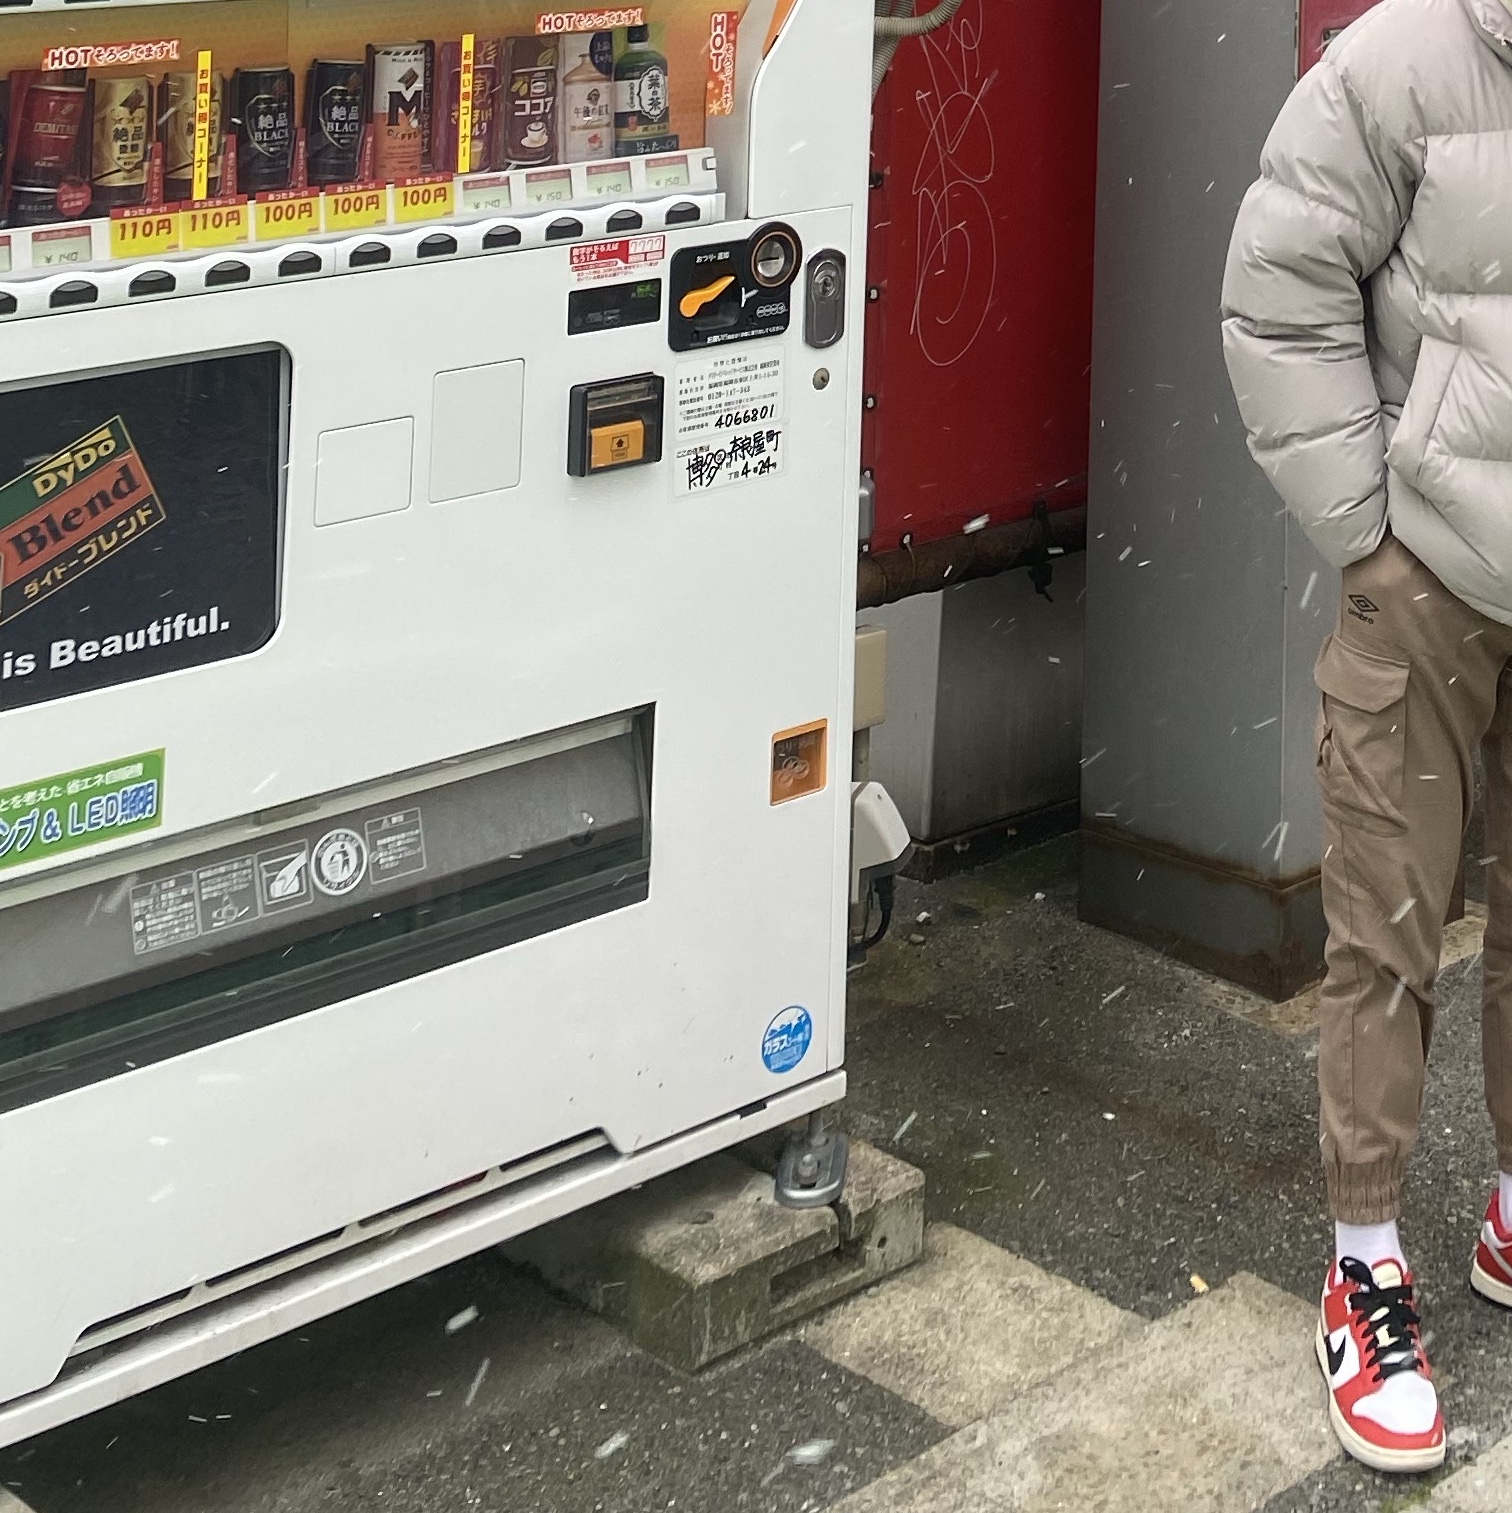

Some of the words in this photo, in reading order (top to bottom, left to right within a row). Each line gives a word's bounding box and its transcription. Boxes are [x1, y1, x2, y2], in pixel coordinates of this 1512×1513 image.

[386, 90, 422, 127] M
[460, 50, 473, 158] お買い得コーナー
[513, 97, 554, 116] ココア
[196, 68, 211, 185] お買い得コーナー
[333, 194, 380, 215] 100円
[402, 185, 447, 207] 100円
[190, 210, 241, 232] 110円
[264, 202, 313, 223] 100円
[119, 218, 173, 241] 110円
[714, 404, 775, 429] 4066801
[32, 438, 117, 498] DyDo
[8, 462, 141, 566] Blend
[23, 502, 155, 600] ダイドーブレンド
[1346, 606, 1375, 626] umbro
[2, 651, 37, 680] is
[49, 606, 231, 670] Beautiful.
